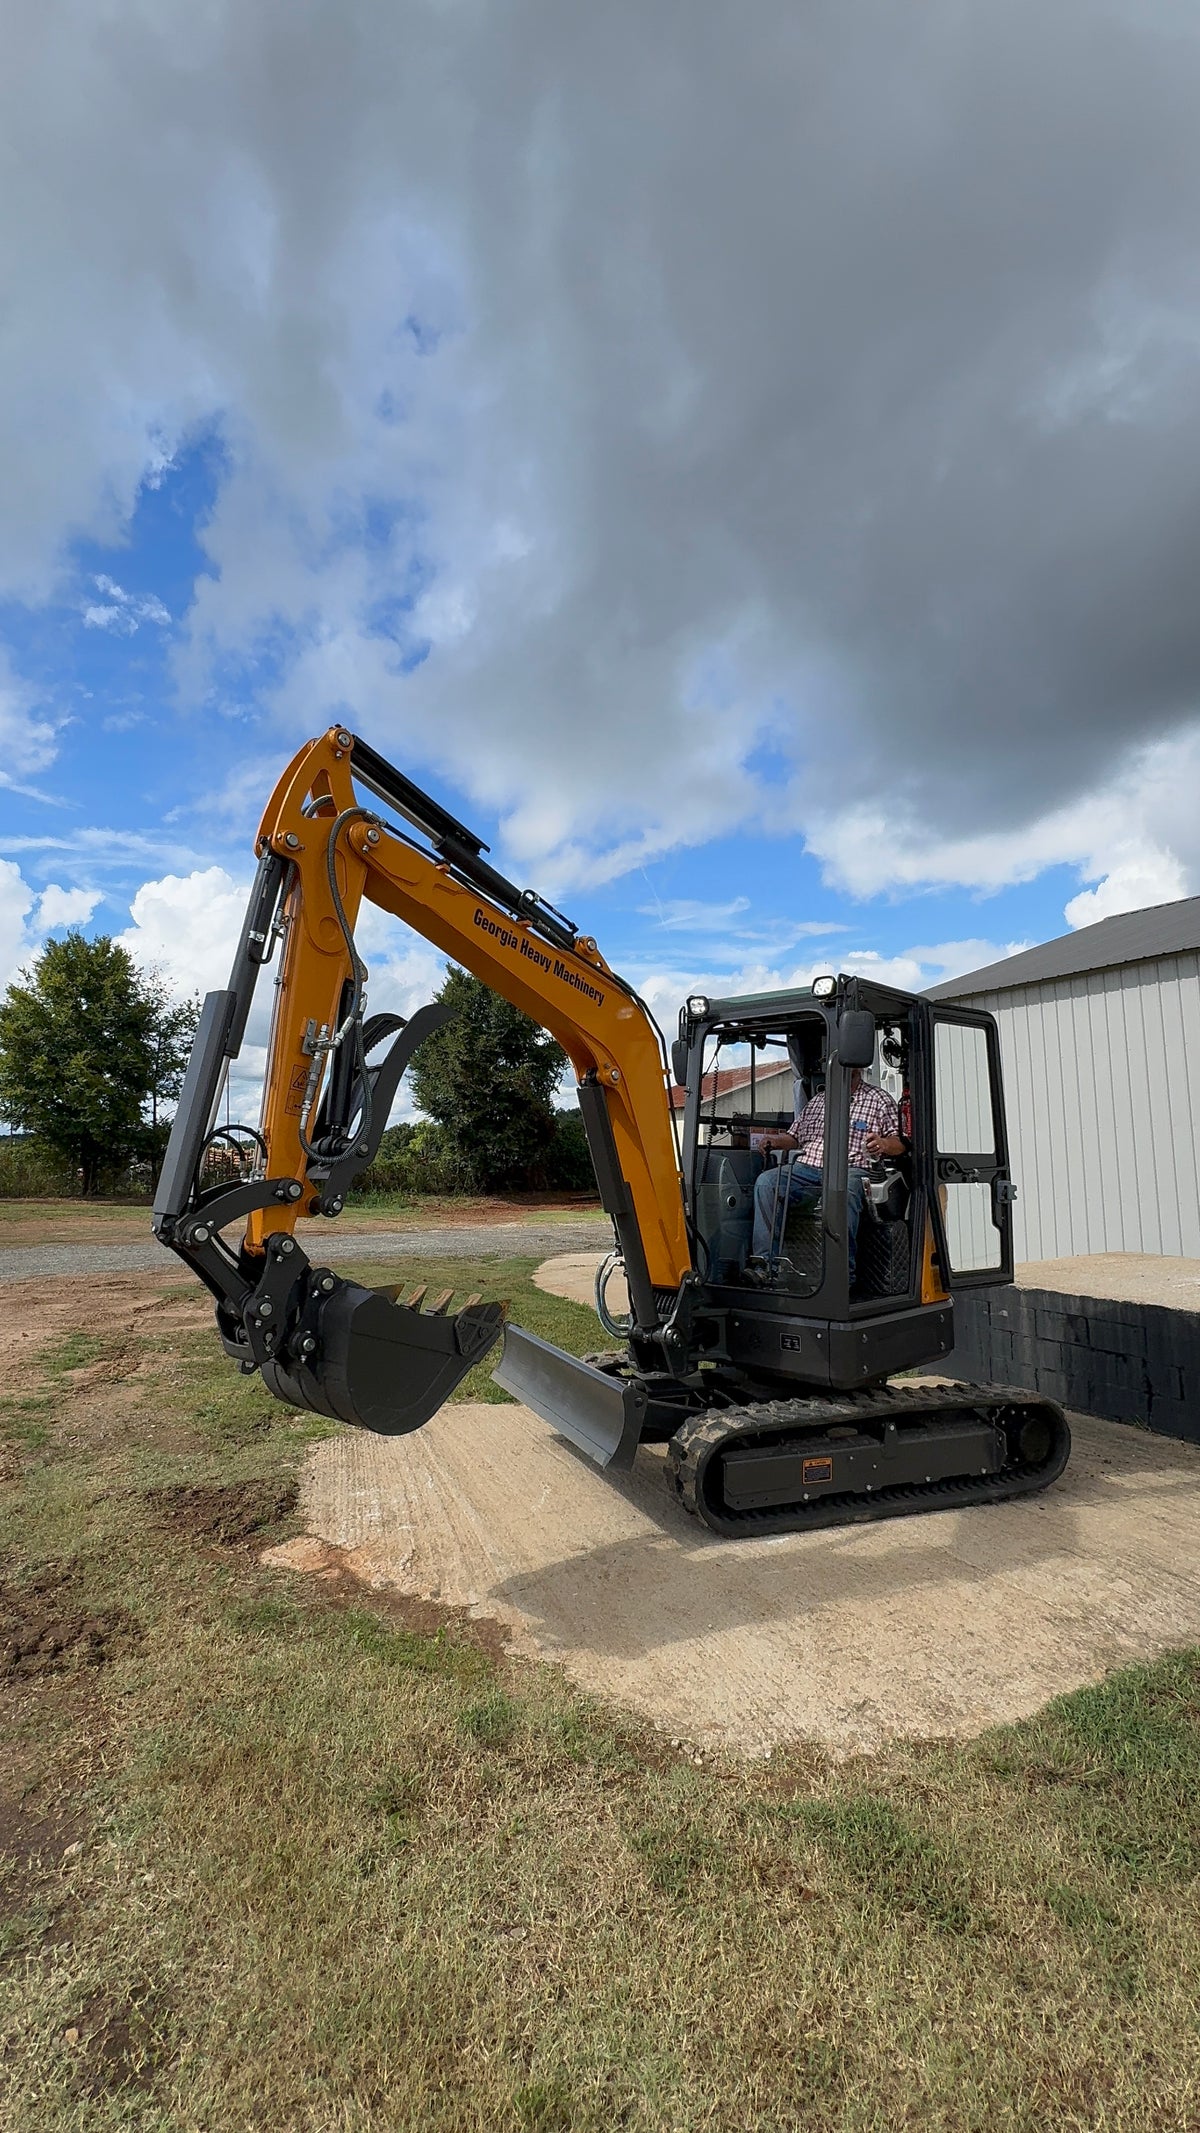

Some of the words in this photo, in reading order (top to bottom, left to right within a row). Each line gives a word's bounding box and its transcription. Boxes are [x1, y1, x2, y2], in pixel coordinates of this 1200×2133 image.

[474, 908, 518, 949] Georgia
[520, 938, 552, 973] Heavy
[553, 960, 605, 1006] Machinery
